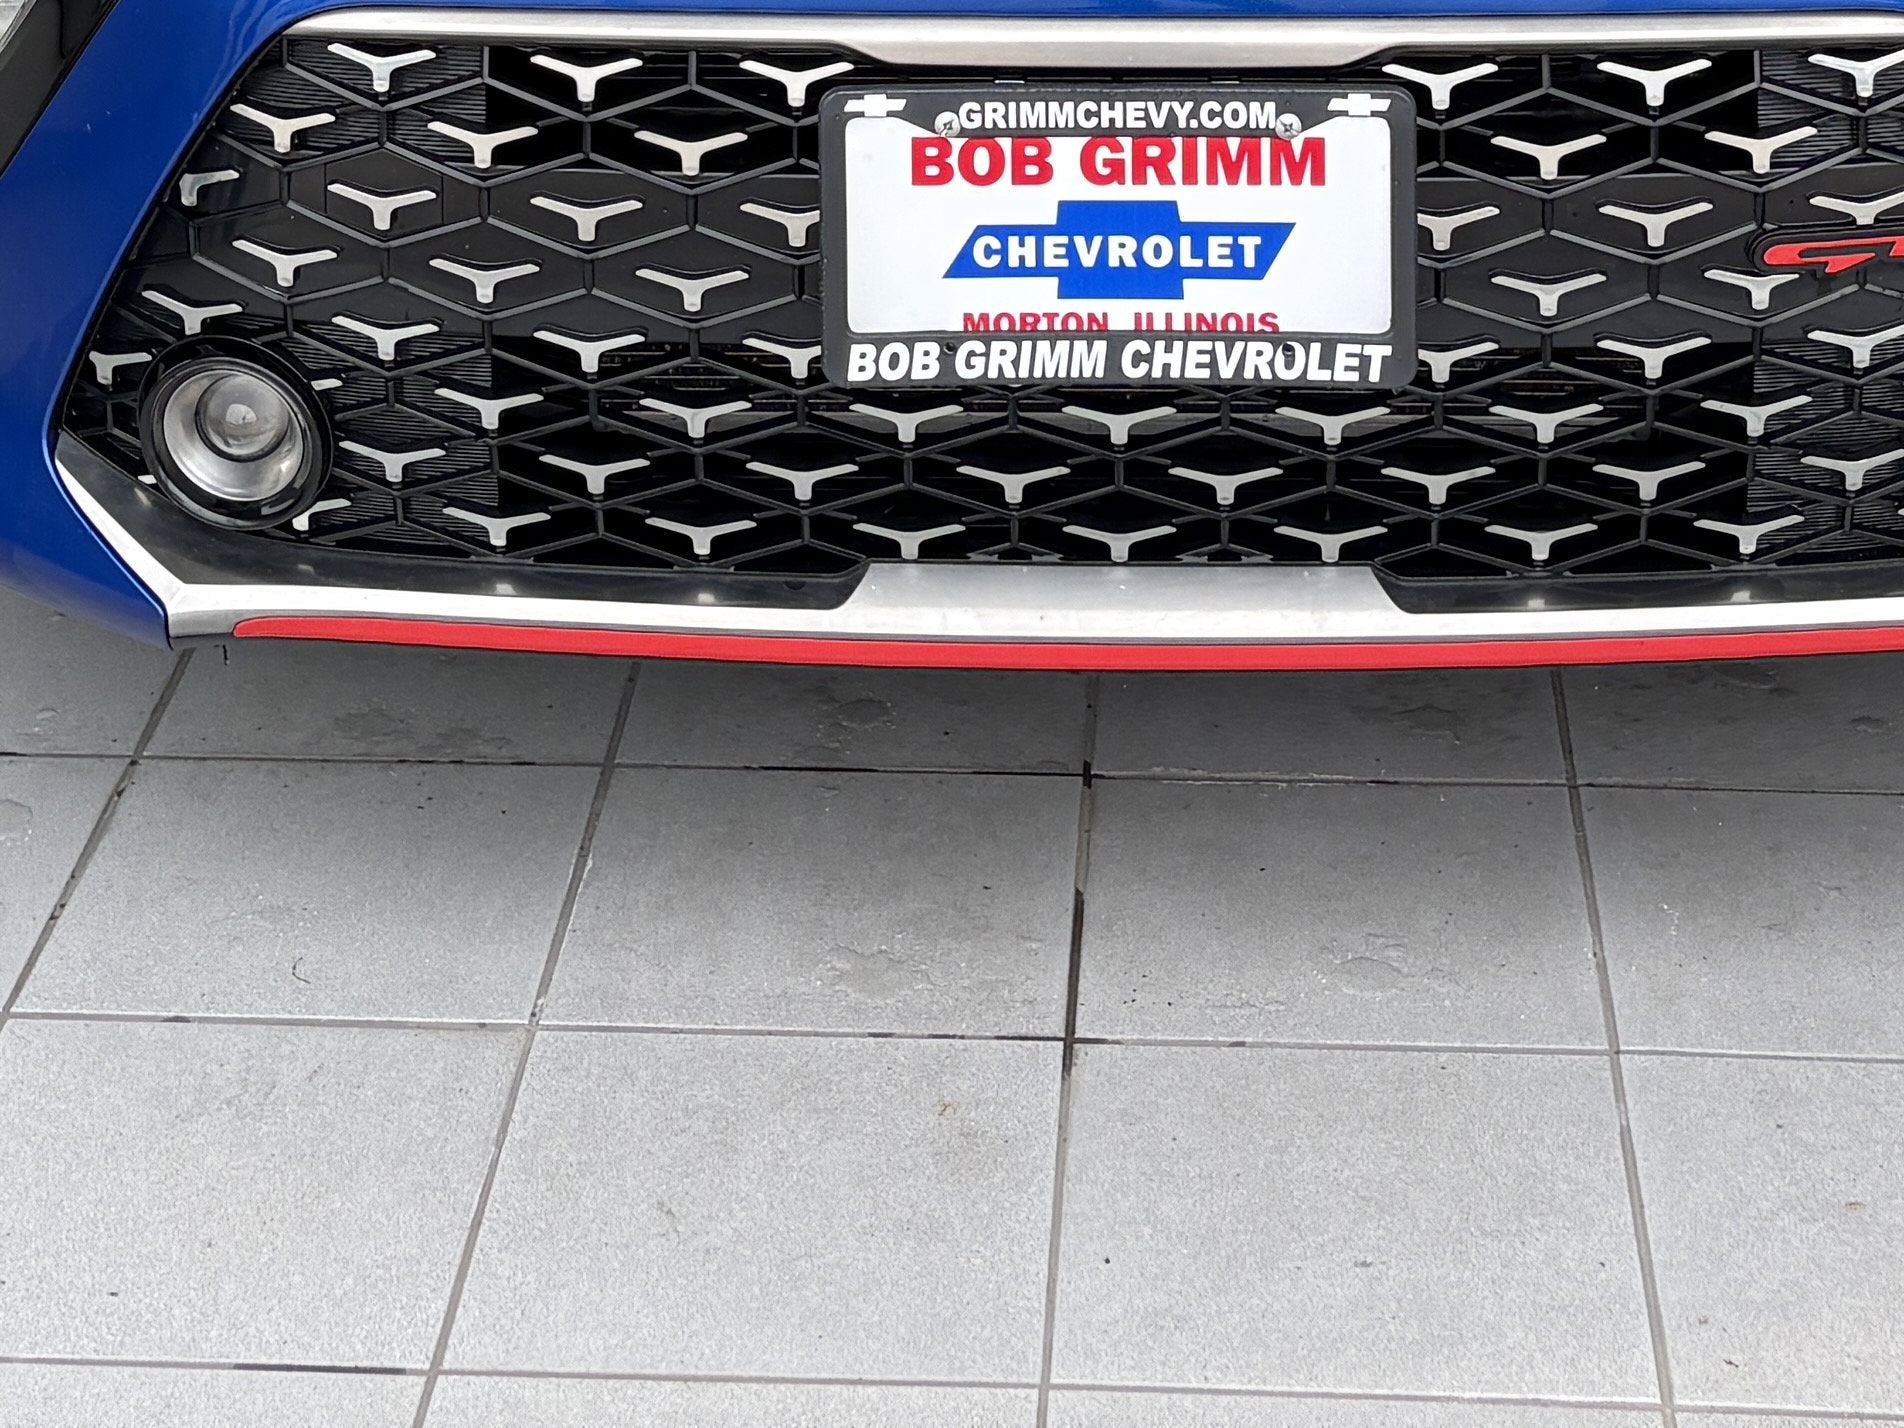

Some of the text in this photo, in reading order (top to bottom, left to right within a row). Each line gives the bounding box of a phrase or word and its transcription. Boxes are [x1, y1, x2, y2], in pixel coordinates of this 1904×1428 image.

[958, 100, 1276, 130] GRIMMCHEVY.COM
[911, 137, 1326, 186] BOB GRIMM
[972, 235, 1262, 269] CHEVROLET
[962, 312, 1280, 333] MORTON ILLINOIS
[847, 341, 1393, 383] BOB GRIMM CHEVROLET
